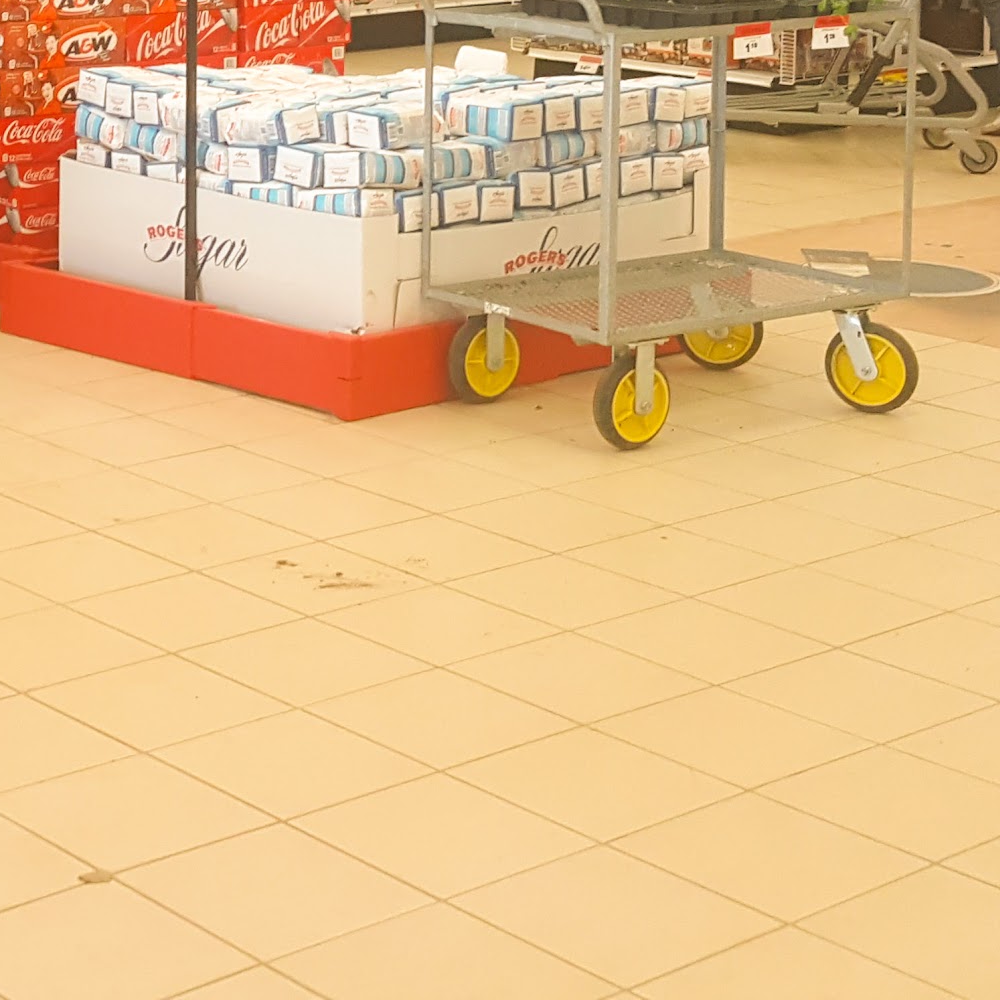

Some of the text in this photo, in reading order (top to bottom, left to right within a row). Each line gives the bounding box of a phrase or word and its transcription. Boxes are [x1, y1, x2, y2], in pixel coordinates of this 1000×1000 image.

[137, 8, 212, 61] Coca-Cla
[255, 0, 327, 51] Coca-Cola
[66, 34, 112, 56] A&W
[3, 117, 66, 146] Coca-Cola
[23, 168, 56, 182] Coca-Cola
[147, 225, 204, 251] ROGES
[504, 250, 568, 275] ROGERS
